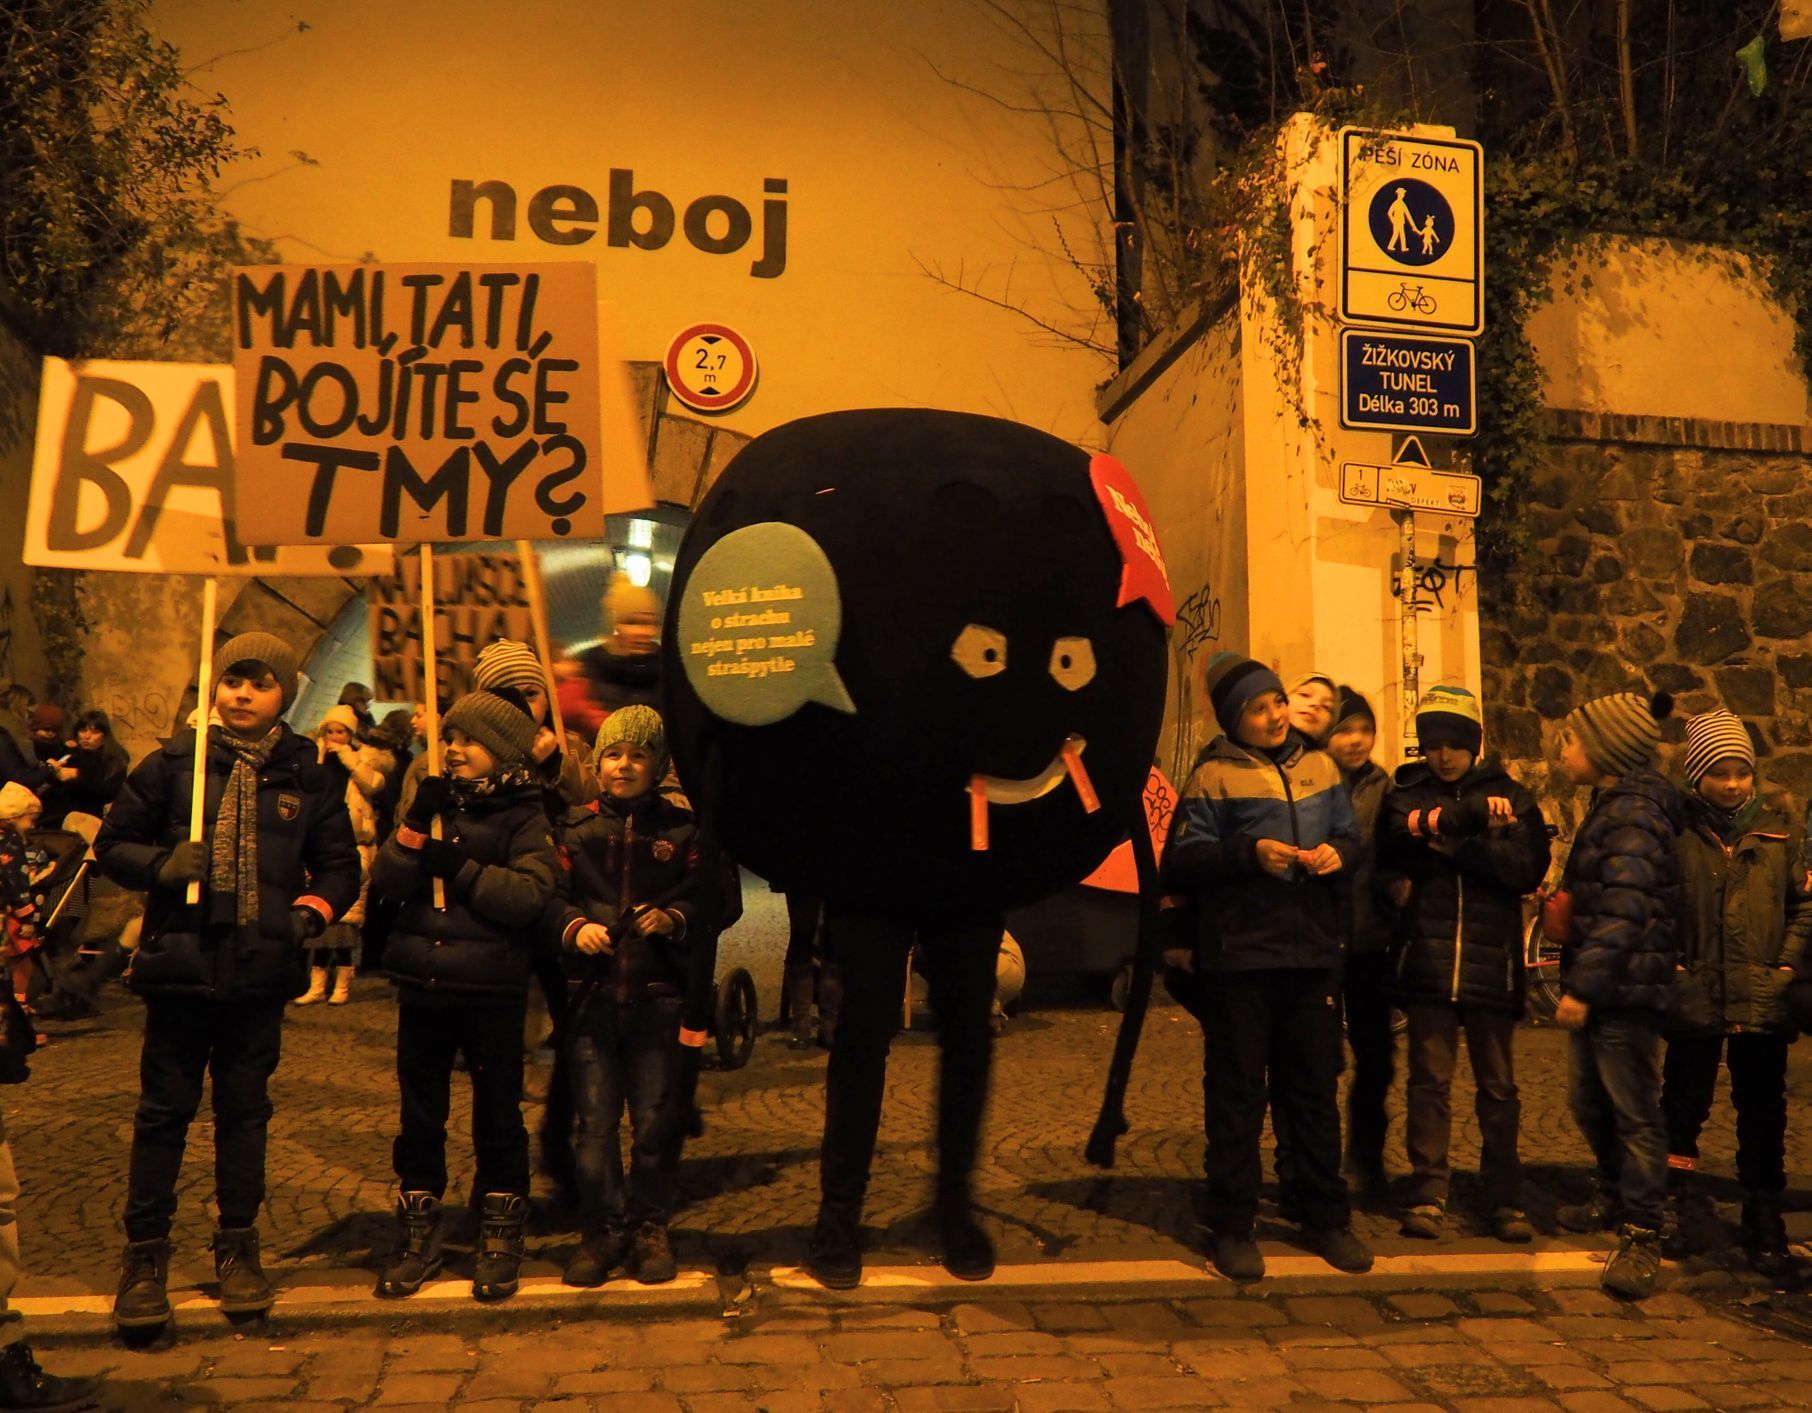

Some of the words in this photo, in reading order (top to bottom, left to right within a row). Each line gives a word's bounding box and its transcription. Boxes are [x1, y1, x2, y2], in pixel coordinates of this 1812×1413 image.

[1411, 151, 1460, 173] ZÓNA
[448, 168, 788, 279] neboj
[236, 268, 398, 358] MAMI,
[401, 270, 553, 360] TATI,
[695, 348, 727, 371] 2,7
[1361, 342, 1456, 372] ŽIŽKOVSKÝ
[703, 374, 717, 383] m
[1379, 371, 1438, 393] TUNEL
[251, 345, 484, 446] BOJÍTE
[491, 357, 580, 437] SE
[1359, 393, 1405, 414] Délka
[1409, 396, 1439, 416] 303
[1443, 403, 1460, 418] m
[281, 434, 588, 537] TMY?
[702, 586, 748, 607] Velká
[750, 585, 804, 603] kniha
[710, 617, 722, 629] o
[723, 609, 791, 628] strachu
[690, 637, 734, 656] nejen
[735, 637, 767, 655] pro
[767, 629, 816, 648] malé
[707, 656, 796, 678] strašpytle
